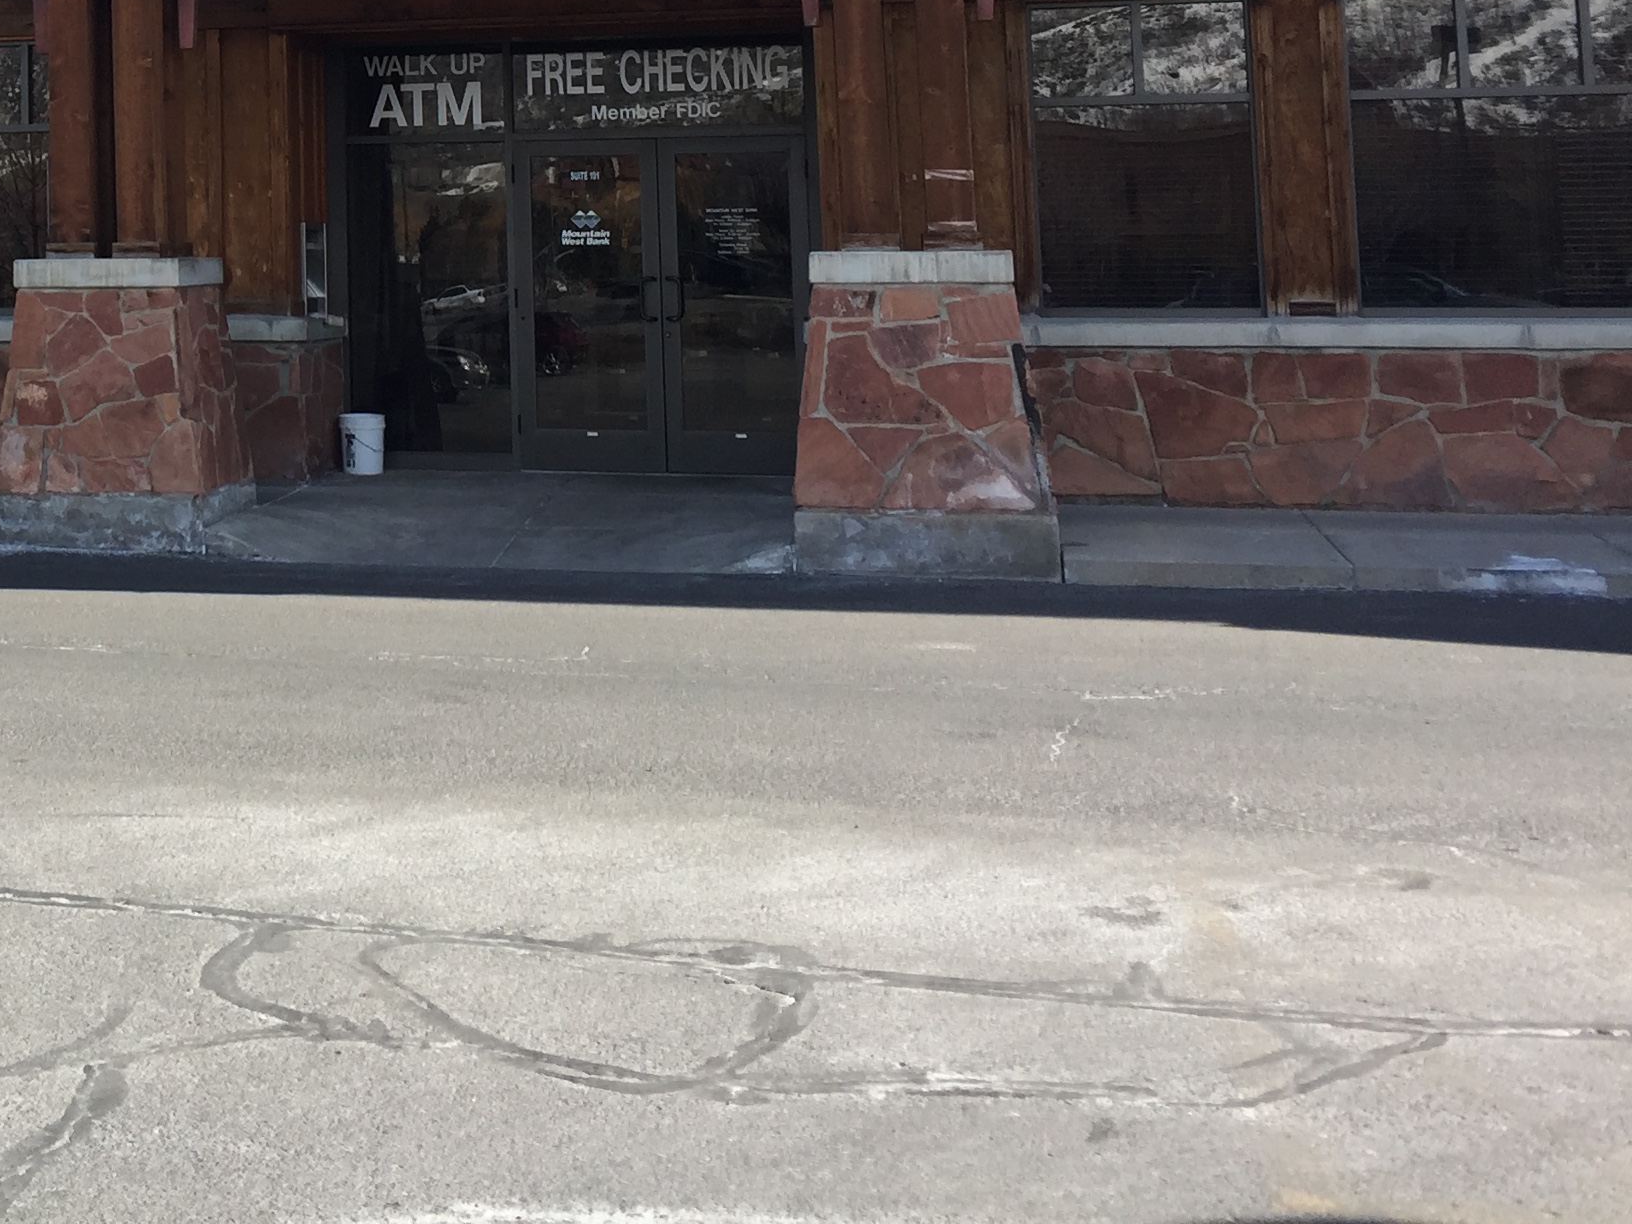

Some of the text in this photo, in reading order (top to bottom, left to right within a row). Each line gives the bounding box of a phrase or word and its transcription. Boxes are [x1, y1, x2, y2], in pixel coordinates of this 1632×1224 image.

[364, 52, 485, 77] WALK UP
[525, 45, 789, 95] FREE CHECKING
[369, 81, 483, 127] ATM
[591, 102, 722, 121] Member FDIC
[561, 229, 610, 238] Mountain
[561, 237, 610, 246] West Bank
